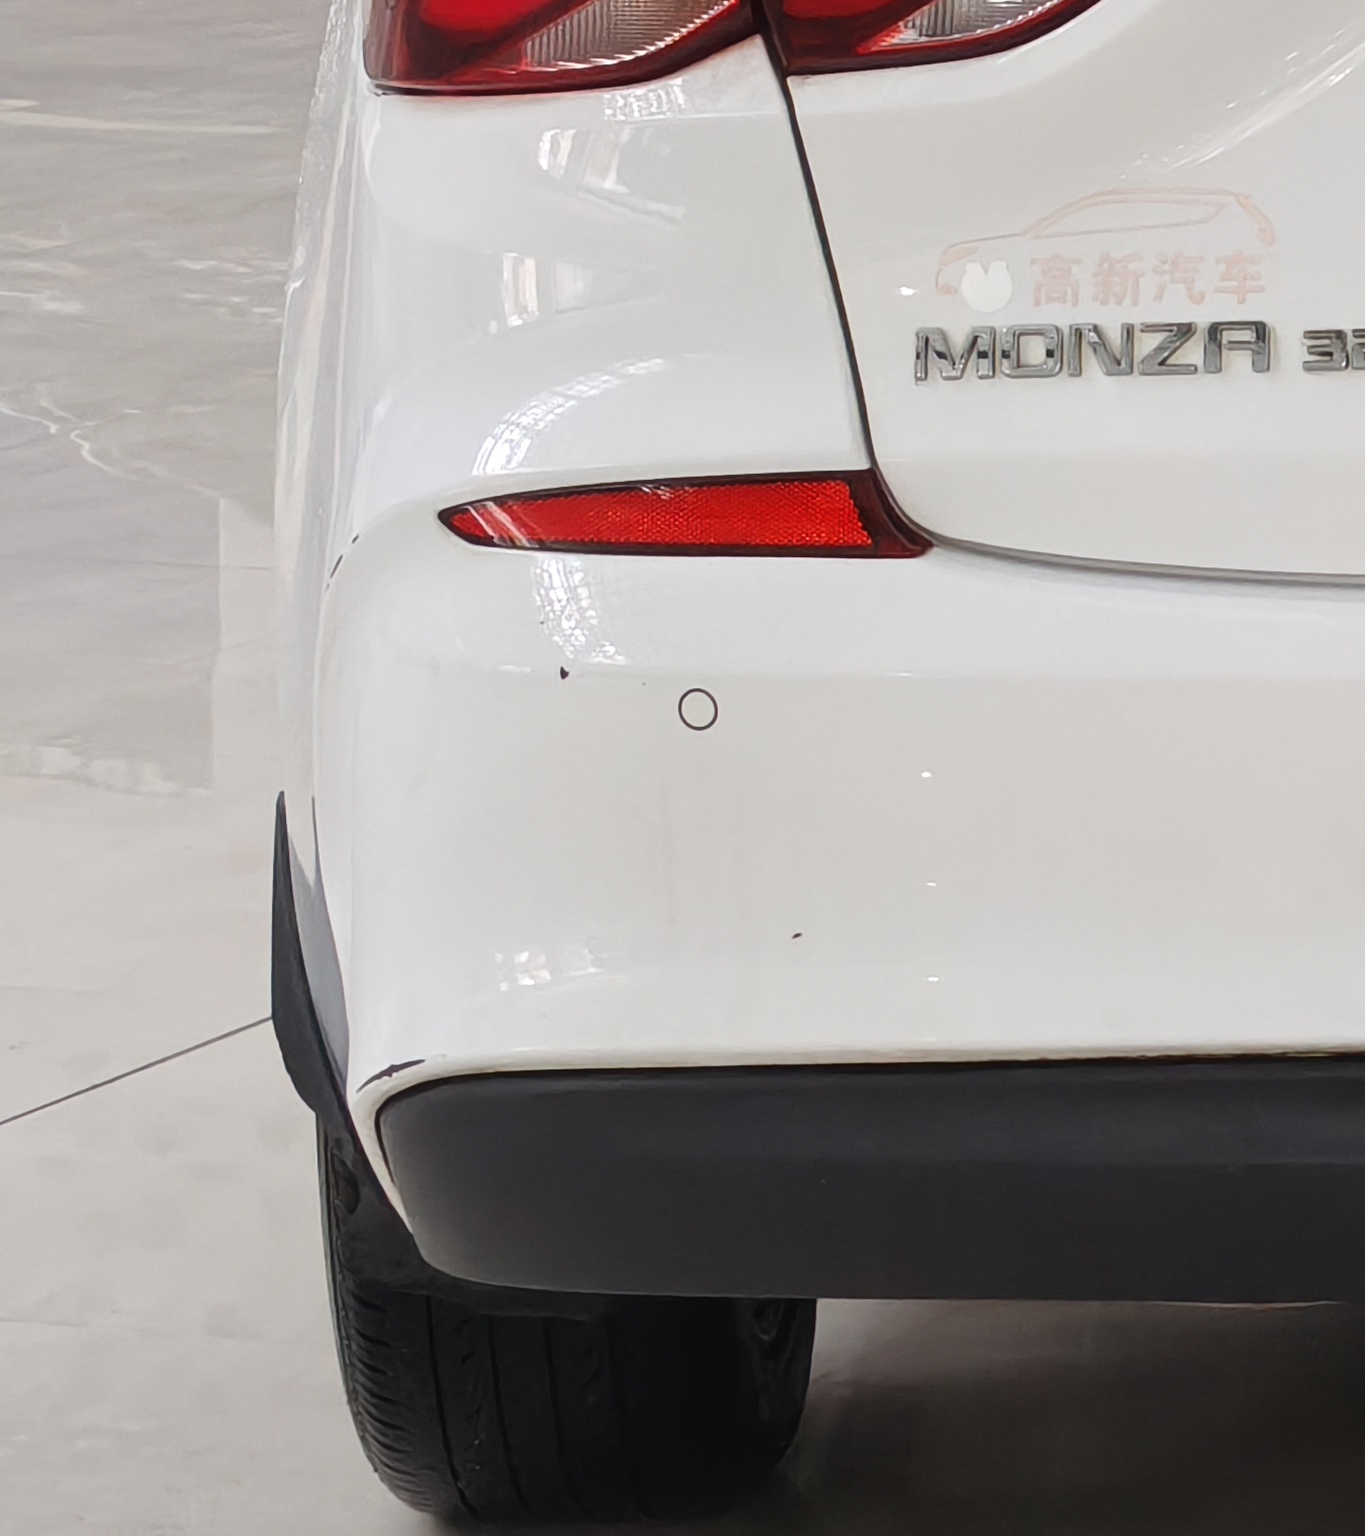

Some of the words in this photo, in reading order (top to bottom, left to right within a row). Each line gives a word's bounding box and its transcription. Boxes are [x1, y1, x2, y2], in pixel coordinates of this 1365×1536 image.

[1029, 250, 1268, 307] 高新汽车
[913, 320, 1271, 382] MONZA
